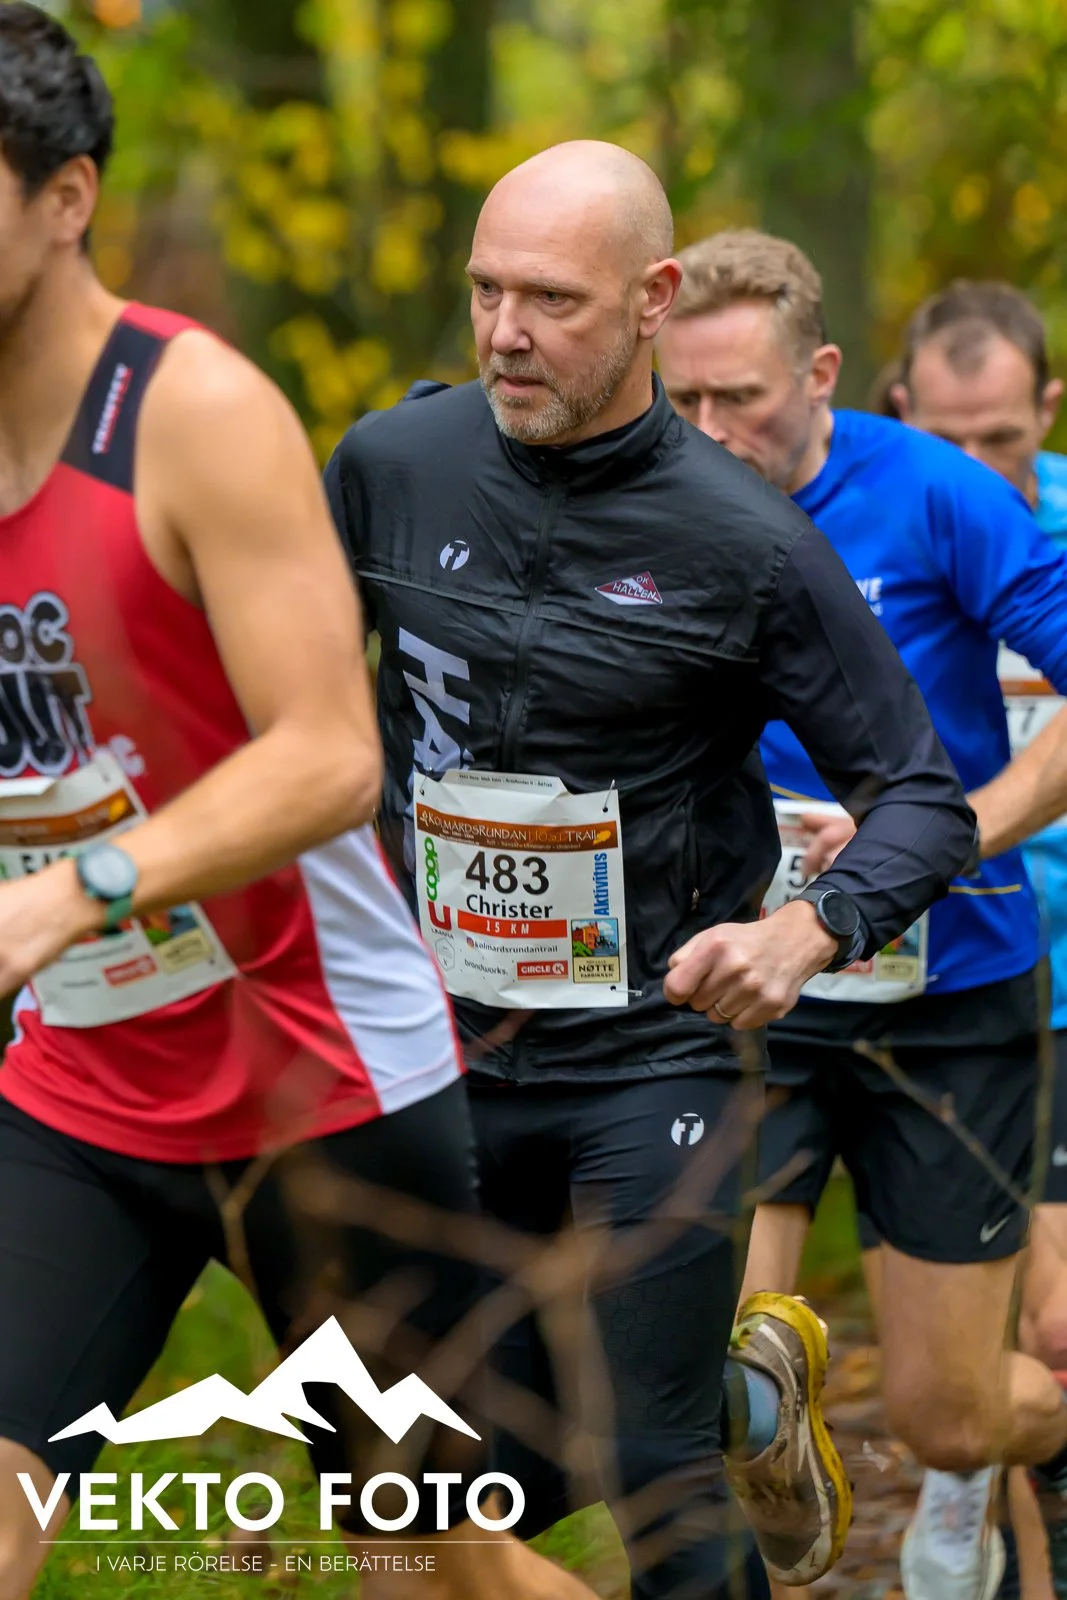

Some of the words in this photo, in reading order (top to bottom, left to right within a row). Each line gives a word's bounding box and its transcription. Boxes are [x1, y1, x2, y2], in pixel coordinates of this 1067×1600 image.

[636, 575, 649, 585] OK
[424, 836, 439, 902] coop
[465, 851, 550, 895] 483
[592, 852, 611, 916] Aktivitus
[466, 894, 553, 919] Christer
[484, 919, 501, 932] 15
[509, 921, 530, 936] KM
[520, 965, 551, 975] CIRCLE
